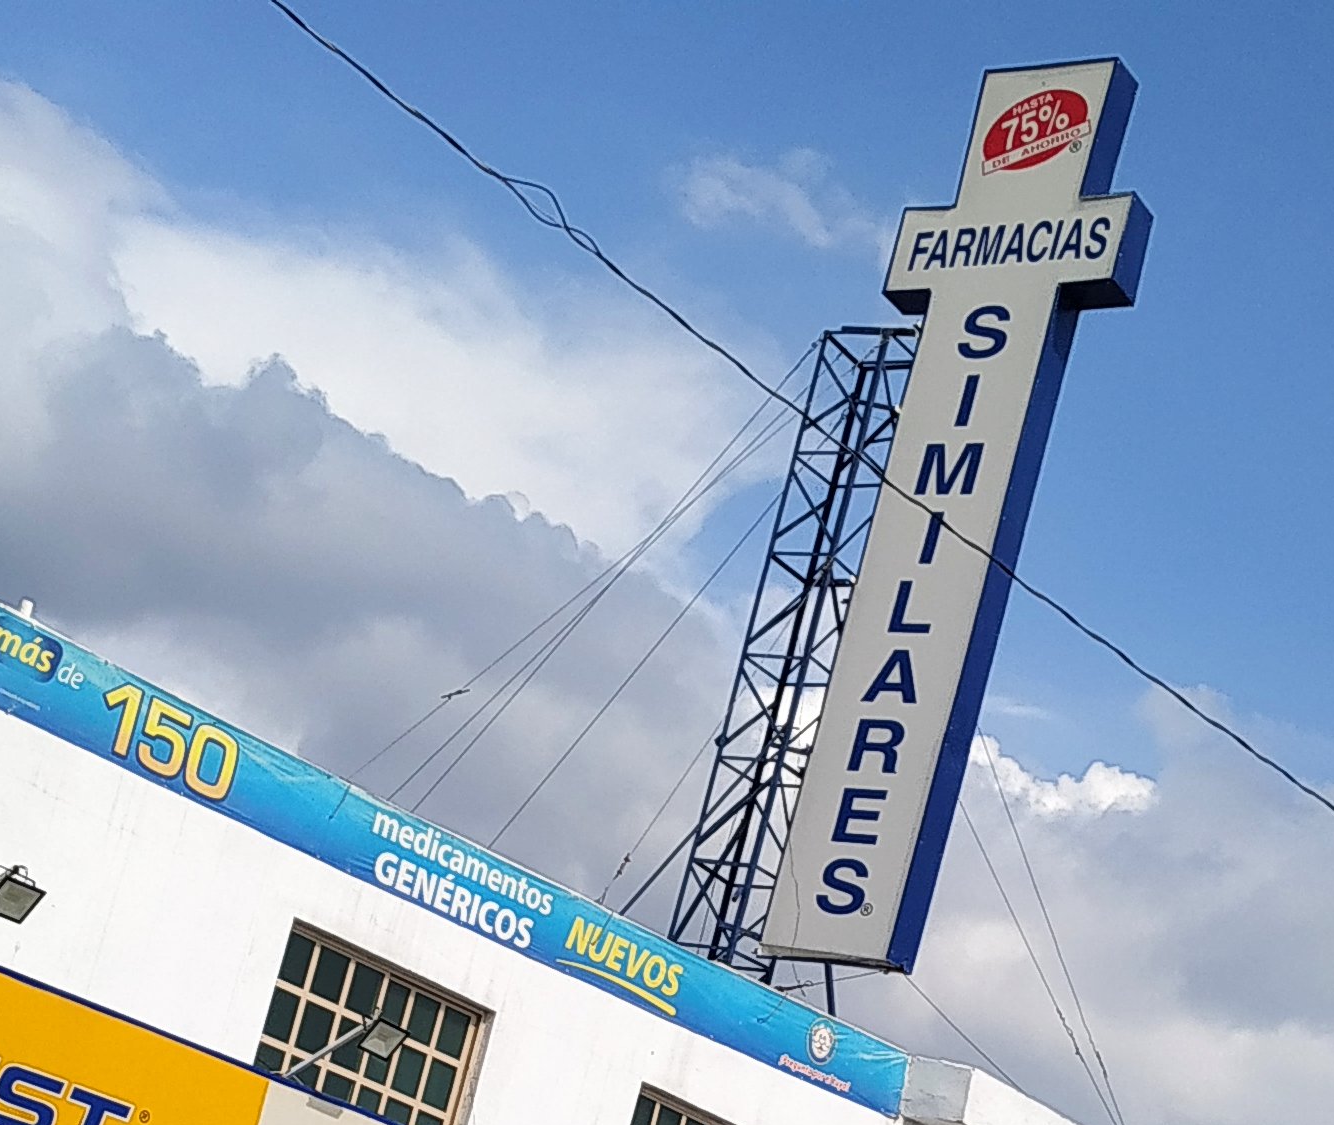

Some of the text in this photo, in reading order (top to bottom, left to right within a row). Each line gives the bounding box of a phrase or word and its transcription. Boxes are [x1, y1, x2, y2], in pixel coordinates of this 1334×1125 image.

[1001, 100, 1070, 151] 75%
[1012, 93, 1055, 116] HASTA
[992, 127, 1082, 169] DE AHORRO
[907, 217, 1111, 271] FARMACIAS
[816, 305, 1011, 917] SIMILARES
[57, 664, 85, 690] de
[103, 682, 238, 801] 150
[372, 810, 554, 916] medicamentos
[373, 851, 684, 997] GENÉRICOS NUEVOS
